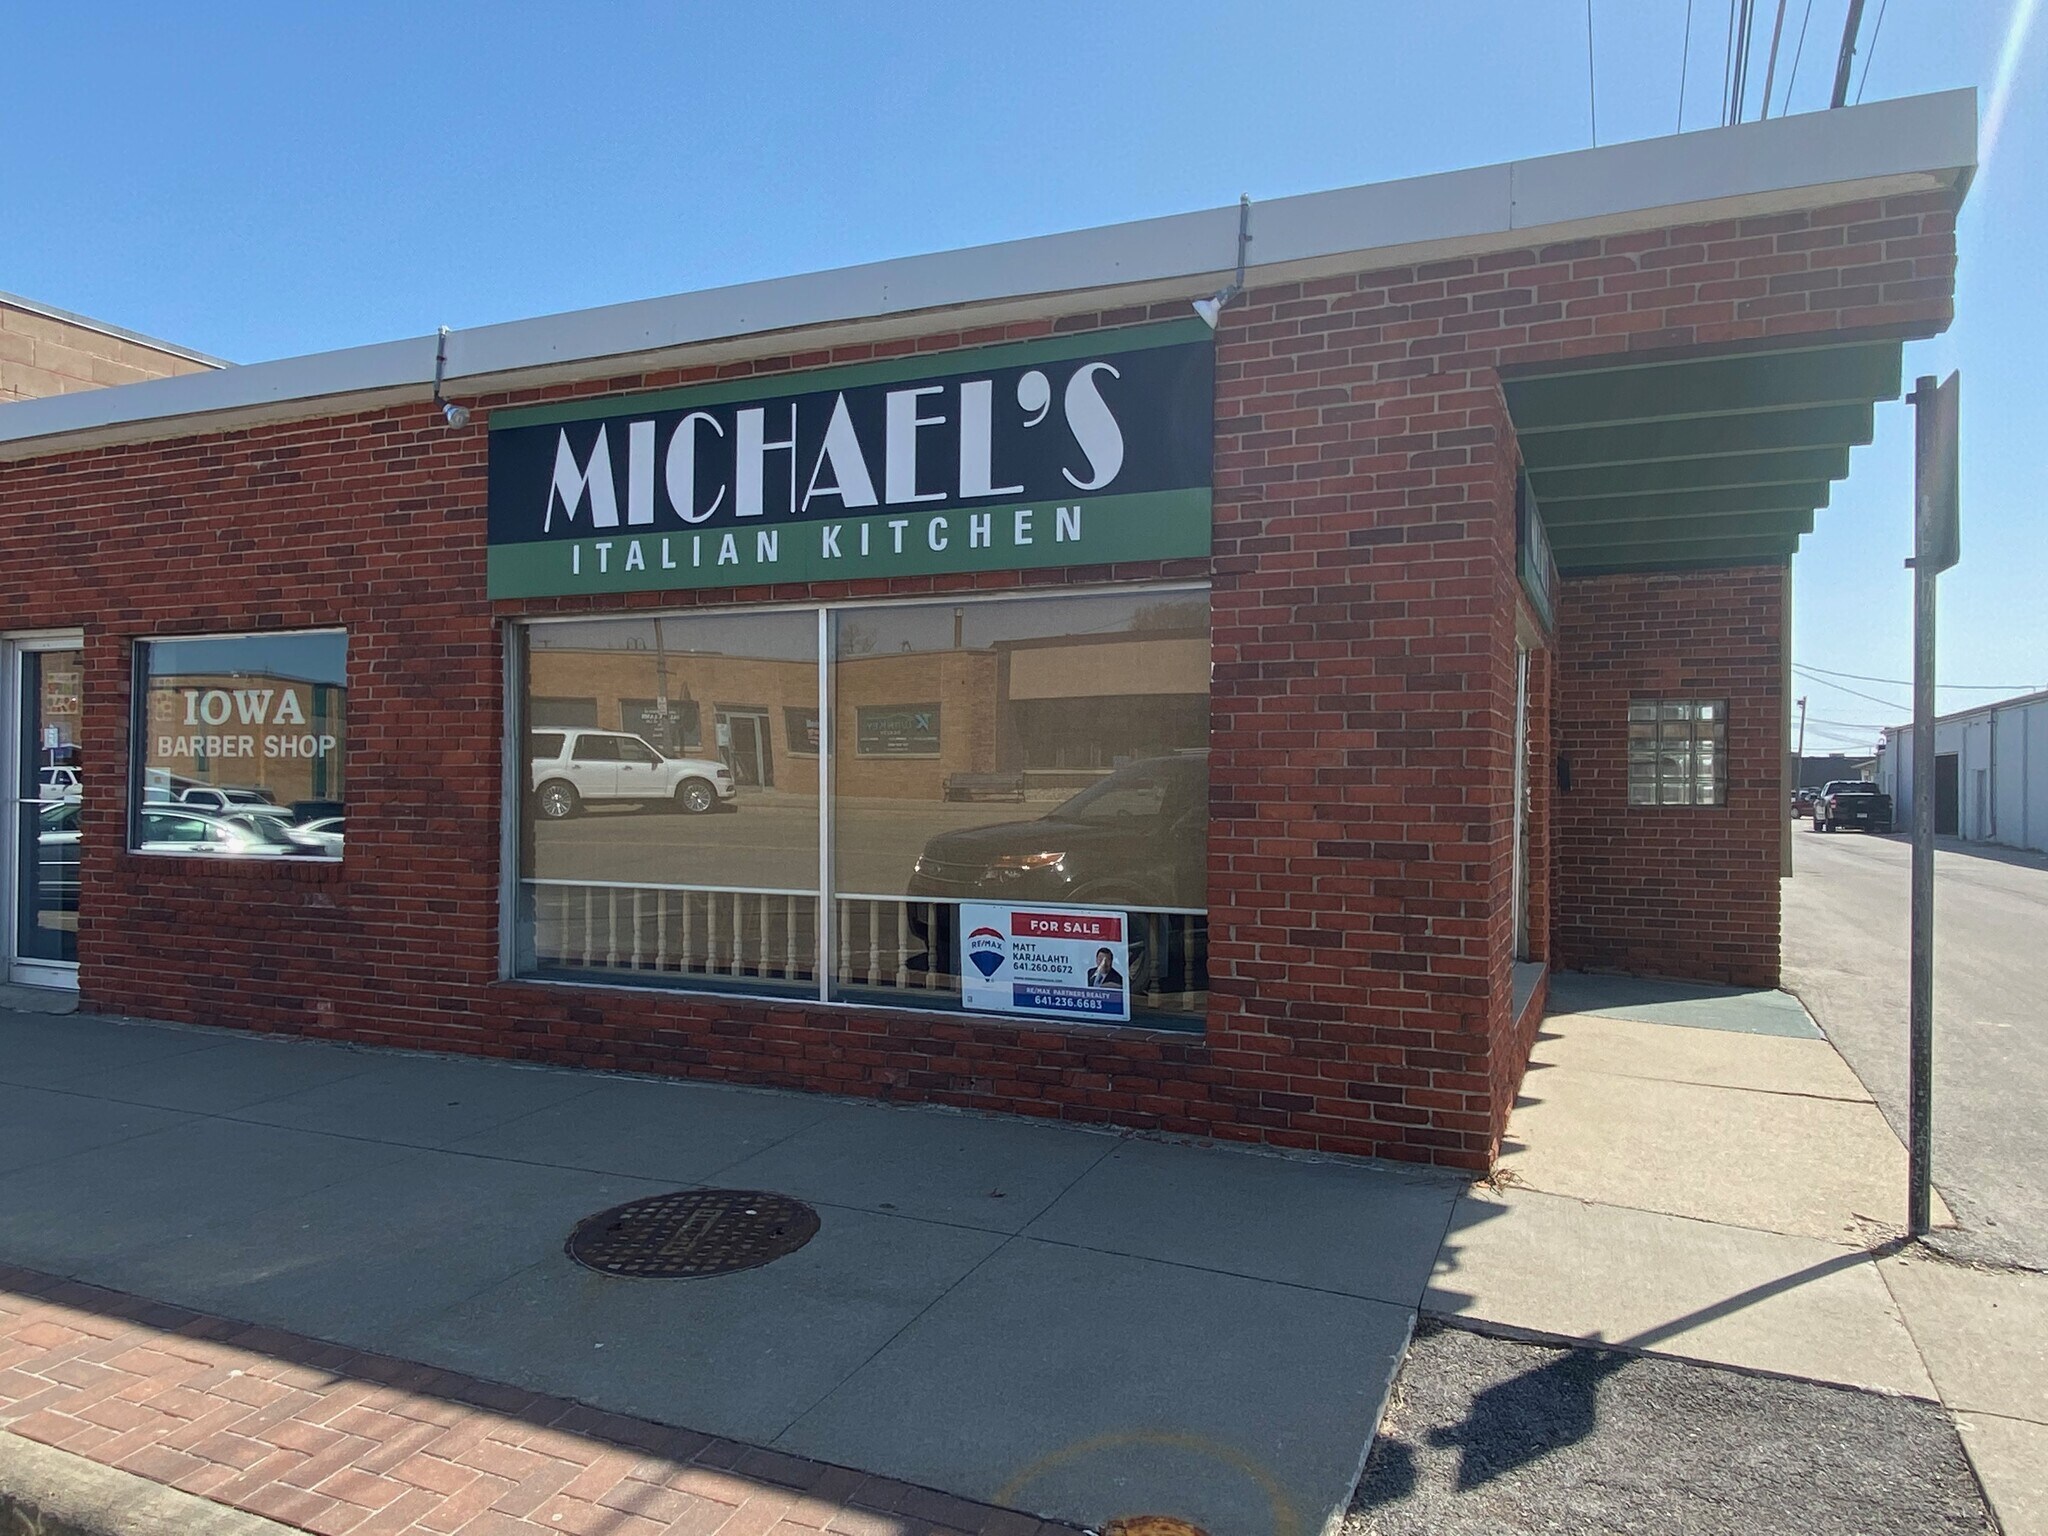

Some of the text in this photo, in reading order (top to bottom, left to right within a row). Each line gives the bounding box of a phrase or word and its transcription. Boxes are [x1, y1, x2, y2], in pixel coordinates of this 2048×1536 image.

[543, 361, 1124, 533] MICHAEL'S
[572, 505, 1082, 575] ITALIAN KITCHEN
[183, 689, 305, 726] IOWA
[158, 734, 336, 758] BARBER SHOP
[1030, 920, 1101, 934] FOR SALE
[971, 940, 1002, 951] RE/MAX
[1012, 943, 1037, 952] MATT
[1012, 953, 1069, 964] KARJALAHTI
[1013, 963, 1073, 974] 641.260.0672
[1026, 987, 1111, 1000] RE/MAX PARTNERS REALTY
[1034, 995, 1103, 1010] 641.236.6683
